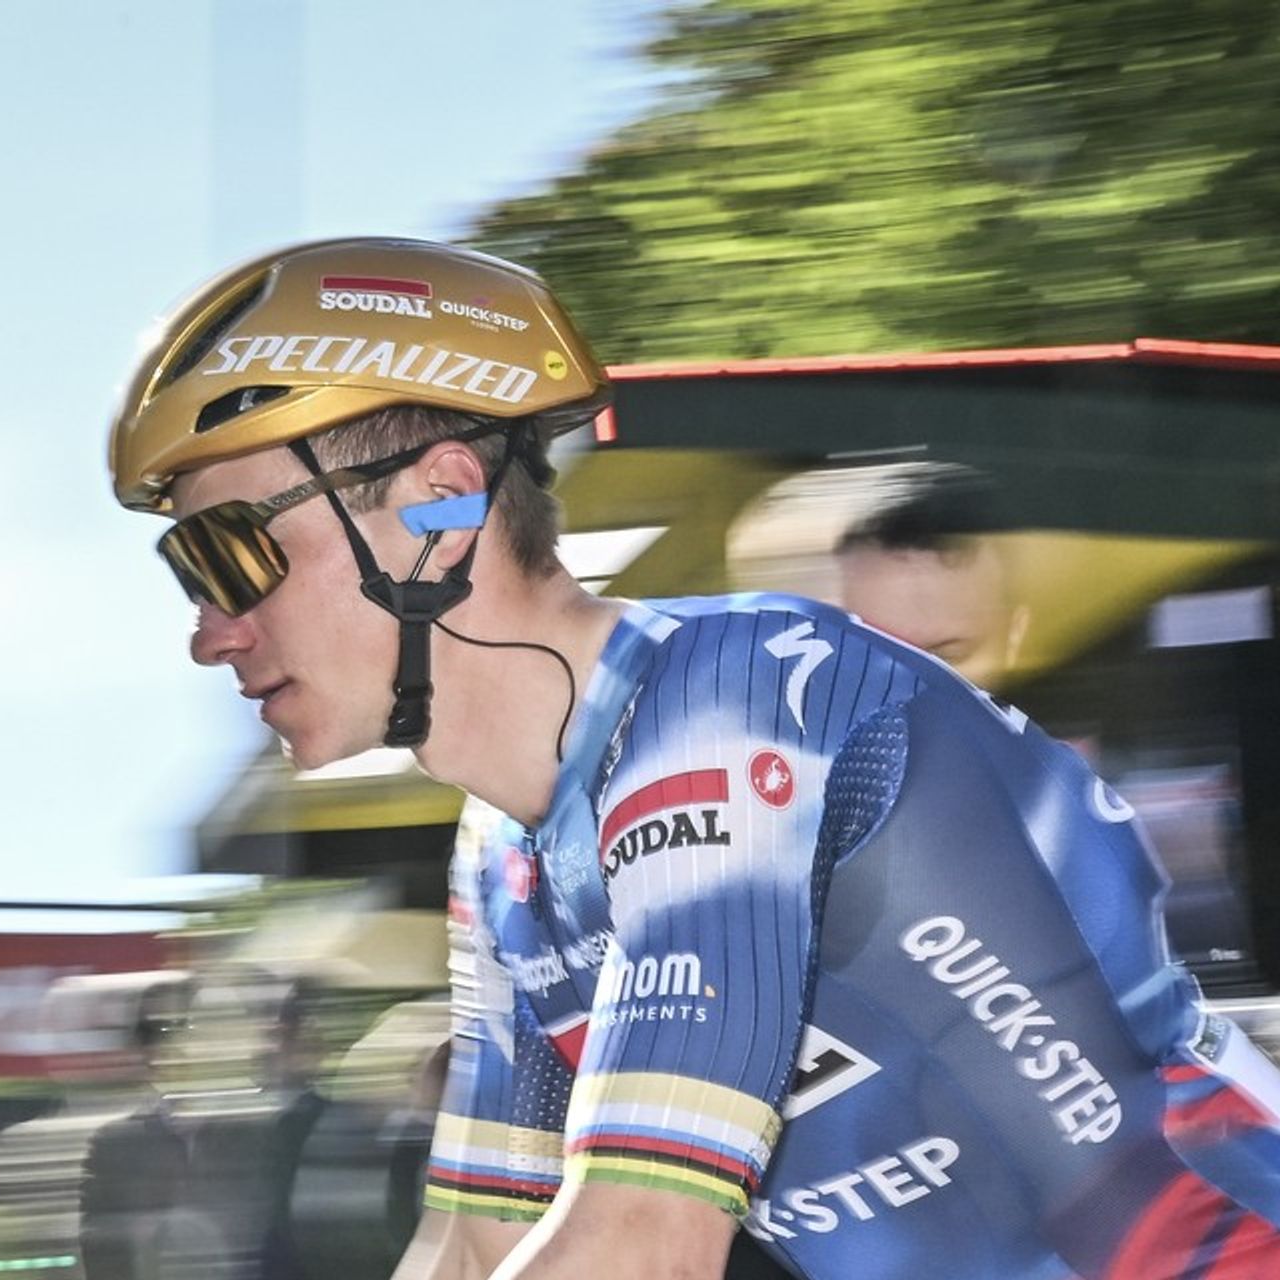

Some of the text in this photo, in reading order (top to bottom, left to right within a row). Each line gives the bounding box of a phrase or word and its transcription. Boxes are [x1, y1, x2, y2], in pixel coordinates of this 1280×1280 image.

[320, 291, 433, 319] SOUDAL
[203, 334, 538, 404] SPECIALIZED
[604, 810, 731, 878] OUDAL
